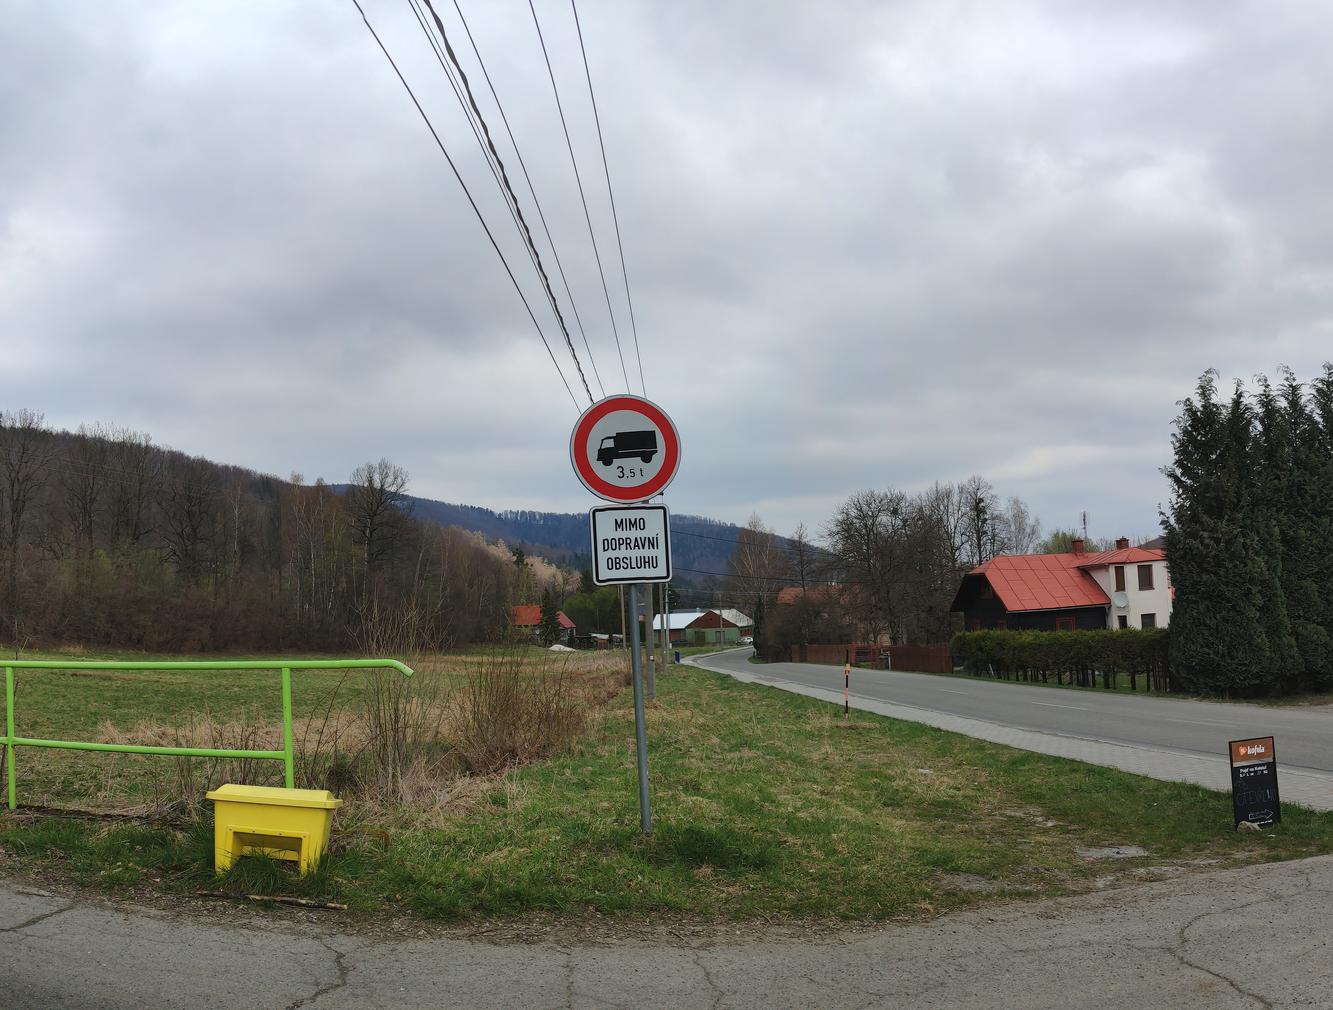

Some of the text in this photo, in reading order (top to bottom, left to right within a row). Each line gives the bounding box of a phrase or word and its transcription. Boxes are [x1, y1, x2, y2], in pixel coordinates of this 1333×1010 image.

[617, 465, 644, 479] 3,5 t
[614, 517, 646, 532] MIMO
[602, 533, 659, 552] DOPRAVNÍ
[606, 555, 659, 571] OBSLUHU
